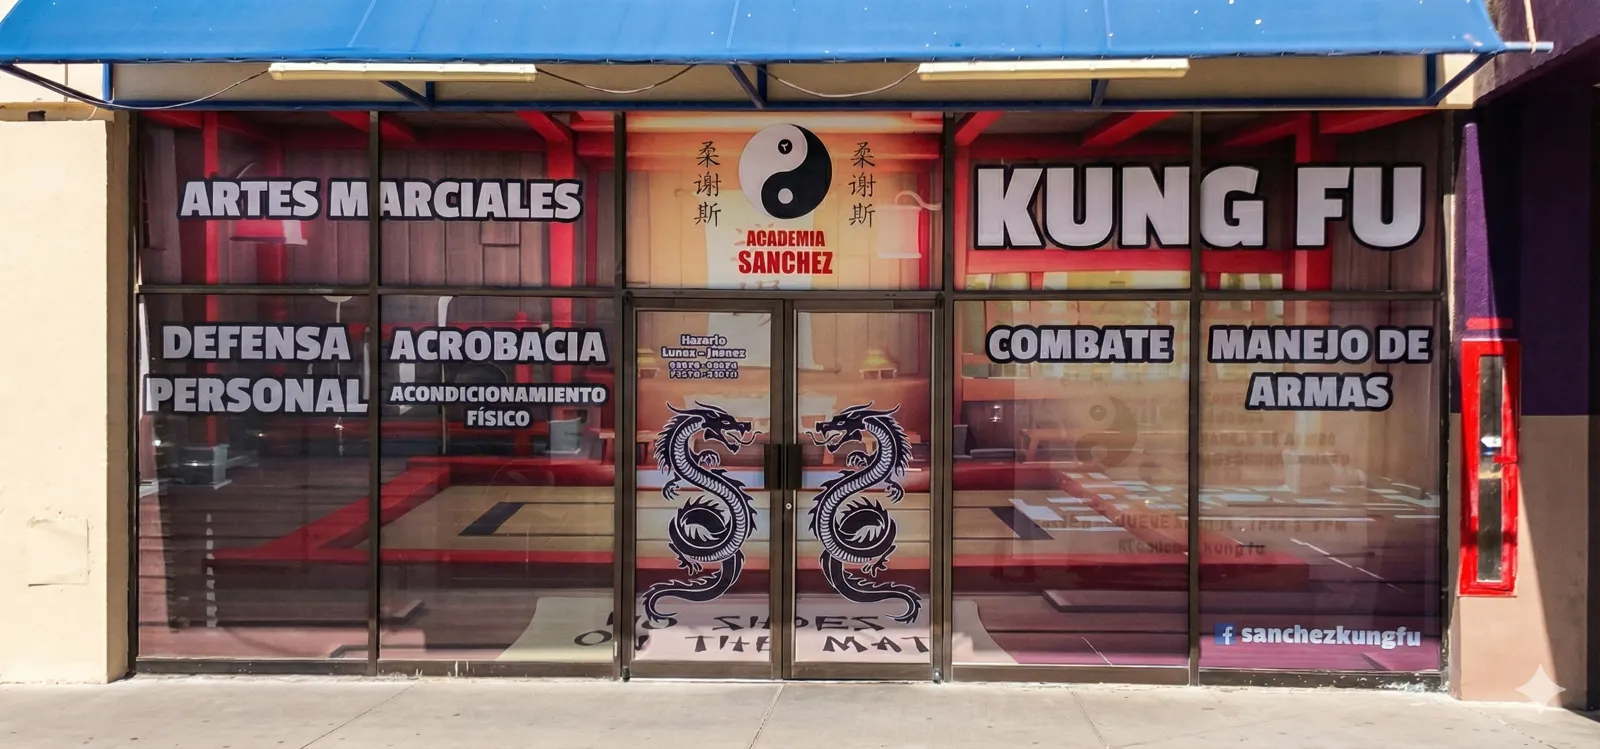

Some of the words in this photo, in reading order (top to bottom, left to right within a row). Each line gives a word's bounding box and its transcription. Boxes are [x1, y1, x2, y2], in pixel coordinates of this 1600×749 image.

[180, 180, 318, 218] ARTES
[330, 180, 581, 219] MARCIALES
[694, 140, 722, 228] 柔谢斯
[848, 141, 877, 229] 柔谢斯
[976, 165, 1265, 248] KUNG
[1296, 166, 1423, 248] FU
[746, 230, 826, 247] ACADEMIA
[738, 250, 833, 275] SANCHEZ
[162, 325, 352, 361] DEFENSA
[390, 330, 607, 363] ACROBACIA
[988, 328, 1174, 361] COMBATE
[1210, 328, 1369, 361] MANEJO
[1379, 328, 1431, 361] DE
[145, 377, 369, 414] PERSONAL
[390, 385, 607, 403] ACONDICIONAMIENTO
[1248, 376, 1390, 408] ARMAS
[466, 408, 531, 427] FÍSICO
[822, 635, 930, 653] MAT
[1241, 624, 1421, 649] sanchezkungfu
